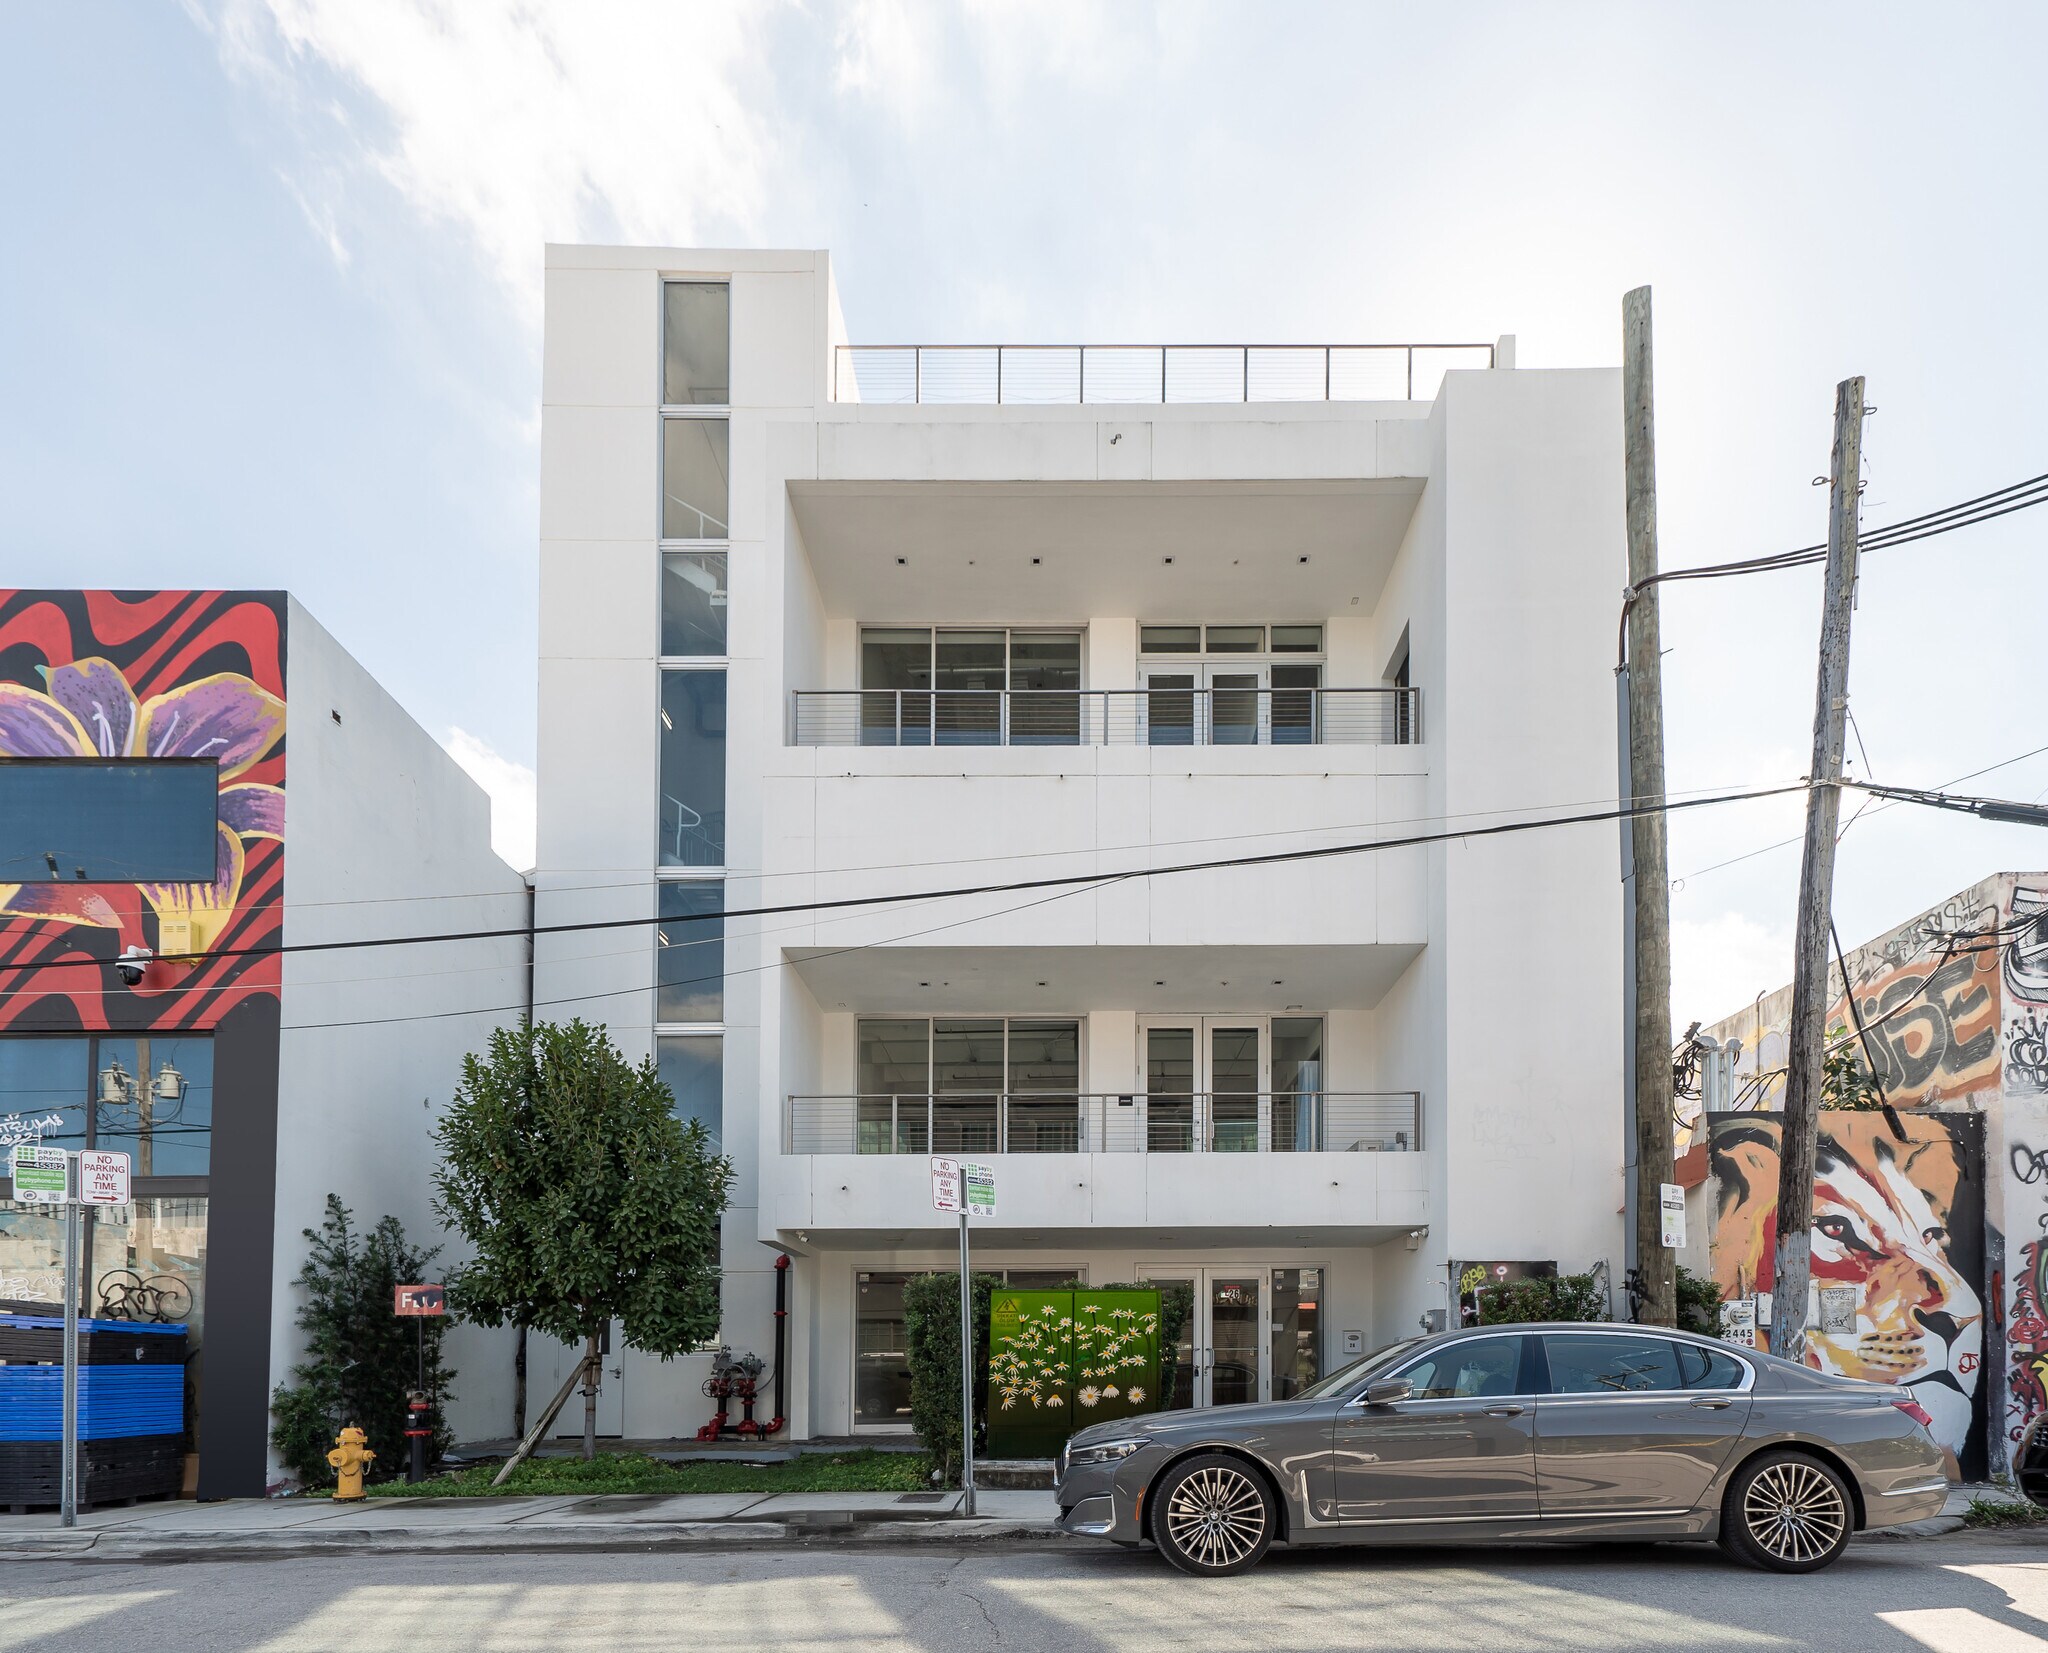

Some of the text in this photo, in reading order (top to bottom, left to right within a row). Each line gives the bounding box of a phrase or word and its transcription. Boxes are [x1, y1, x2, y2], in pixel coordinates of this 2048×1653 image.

[97, 1155, 113, 1164] NO
[33, 1162, 64, 1170] 45382
[84, 1164, 125, 1173] PARKING
[940, 1161, 949, 1170] NO
[95, 1173, 114, 1181] ANY
[933, 1169, 957, 1180] PARKING
[93, 1181, 117, 1190] TIME
[940, 1179, 951, 1187] ANY
[939, 1187, 953, 1197] TIME
[1725, 1329, 1753, 1338] 2445
